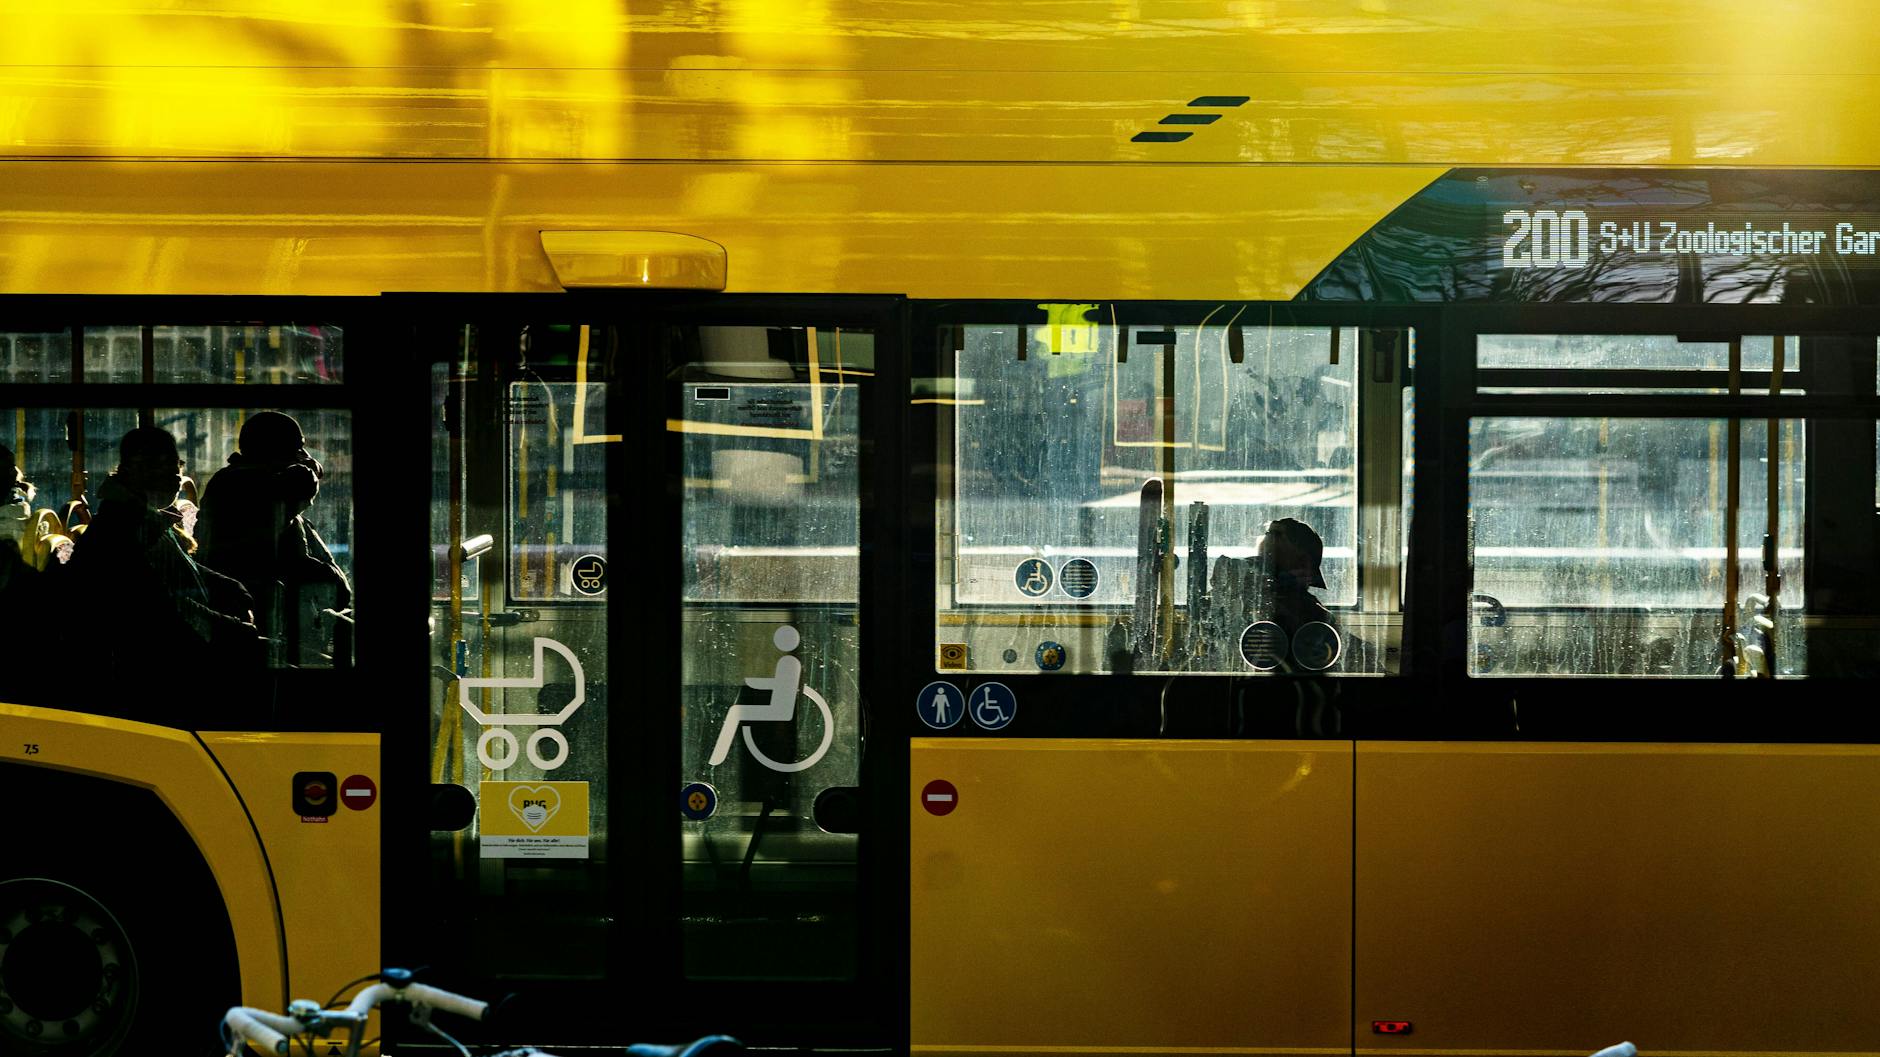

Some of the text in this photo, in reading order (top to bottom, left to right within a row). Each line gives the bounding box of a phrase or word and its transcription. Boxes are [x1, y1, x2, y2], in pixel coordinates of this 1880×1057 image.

[1503, 210, 1880, 268] 200 S+U Zoologischer Gar
[23, 744, 39, 755] 7,5
